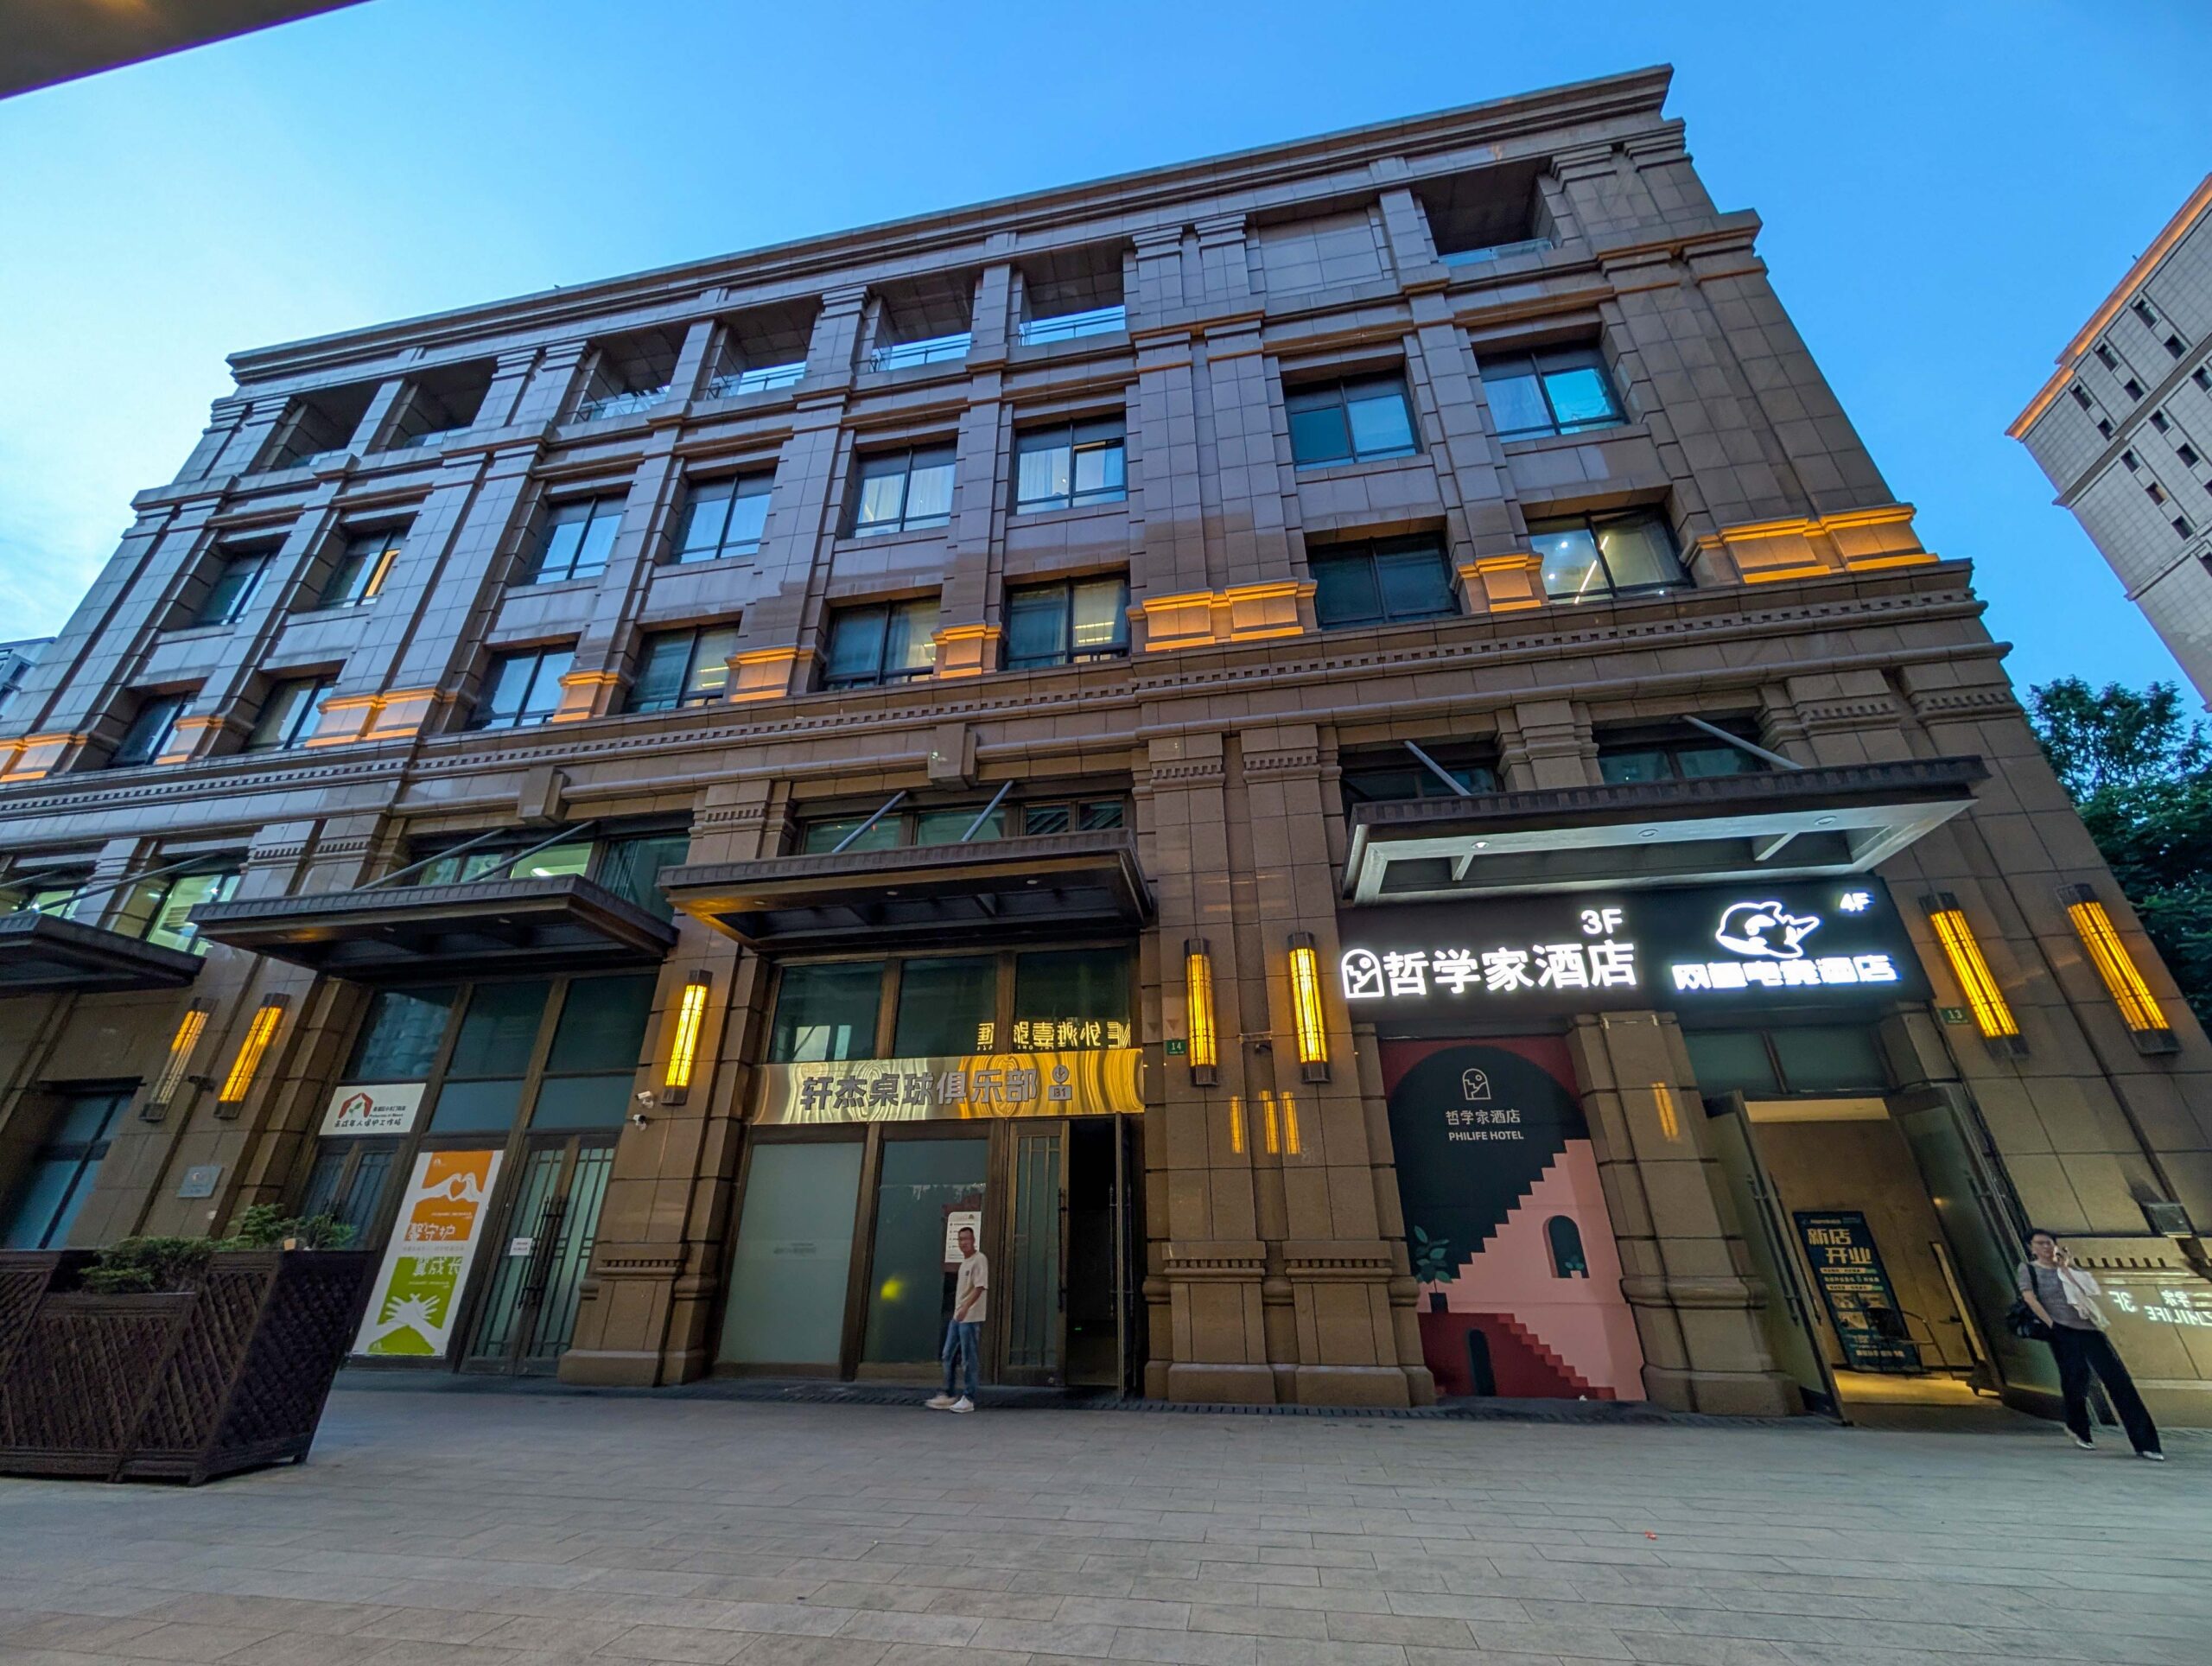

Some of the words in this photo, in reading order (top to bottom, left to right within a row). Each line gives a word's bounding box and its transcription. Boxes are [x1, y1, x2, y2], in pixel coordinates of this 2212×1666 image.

[1580, 908, 1623, 934] 3F
[1382, 939, 1637, 996] 哲学家酒店
[1672, 955, 1897, 990] 网电竞酒店
[1171, 1041, 1182, 1051] 14
[800, 1068, 1037, 1110] 轩杰桌球俱乐部
[1053, 1086, 1067, 1098] B1
[1445, 1109, 1521, 1125] 哲学家酒店
[1448, 1131, 1488, 1141] PHILIFE
[1490, 1130, 1524, 1140] HOTEL
[1807, 1228, 1852, 1245] 新店
[1825, 1247, 1872, 1263] 开业
